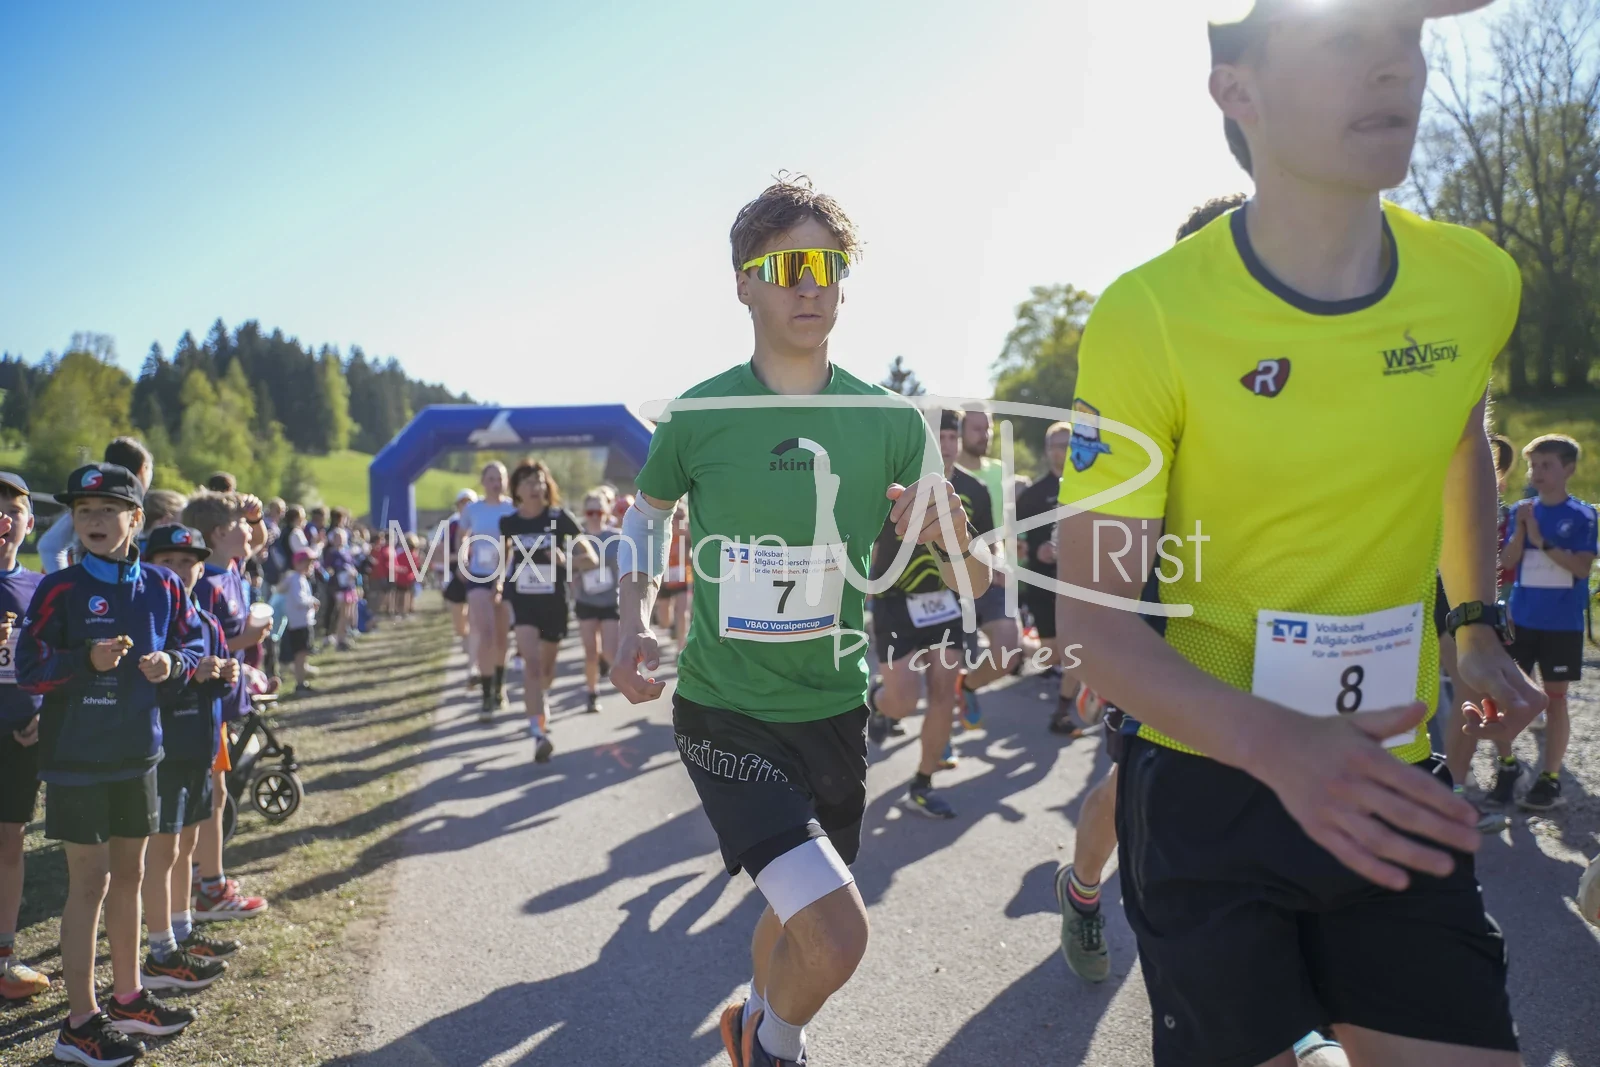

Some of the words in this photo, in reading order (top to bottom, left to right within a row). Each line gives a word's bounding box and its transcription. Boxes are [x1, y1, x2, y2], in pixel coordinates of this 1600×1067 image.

[773, 580, 796, 614] 7
[745, 620, 769, 630] VBAO
[771, 620, 820, 631] Voralpencup
[1335, 664, 1364, 715] 8
